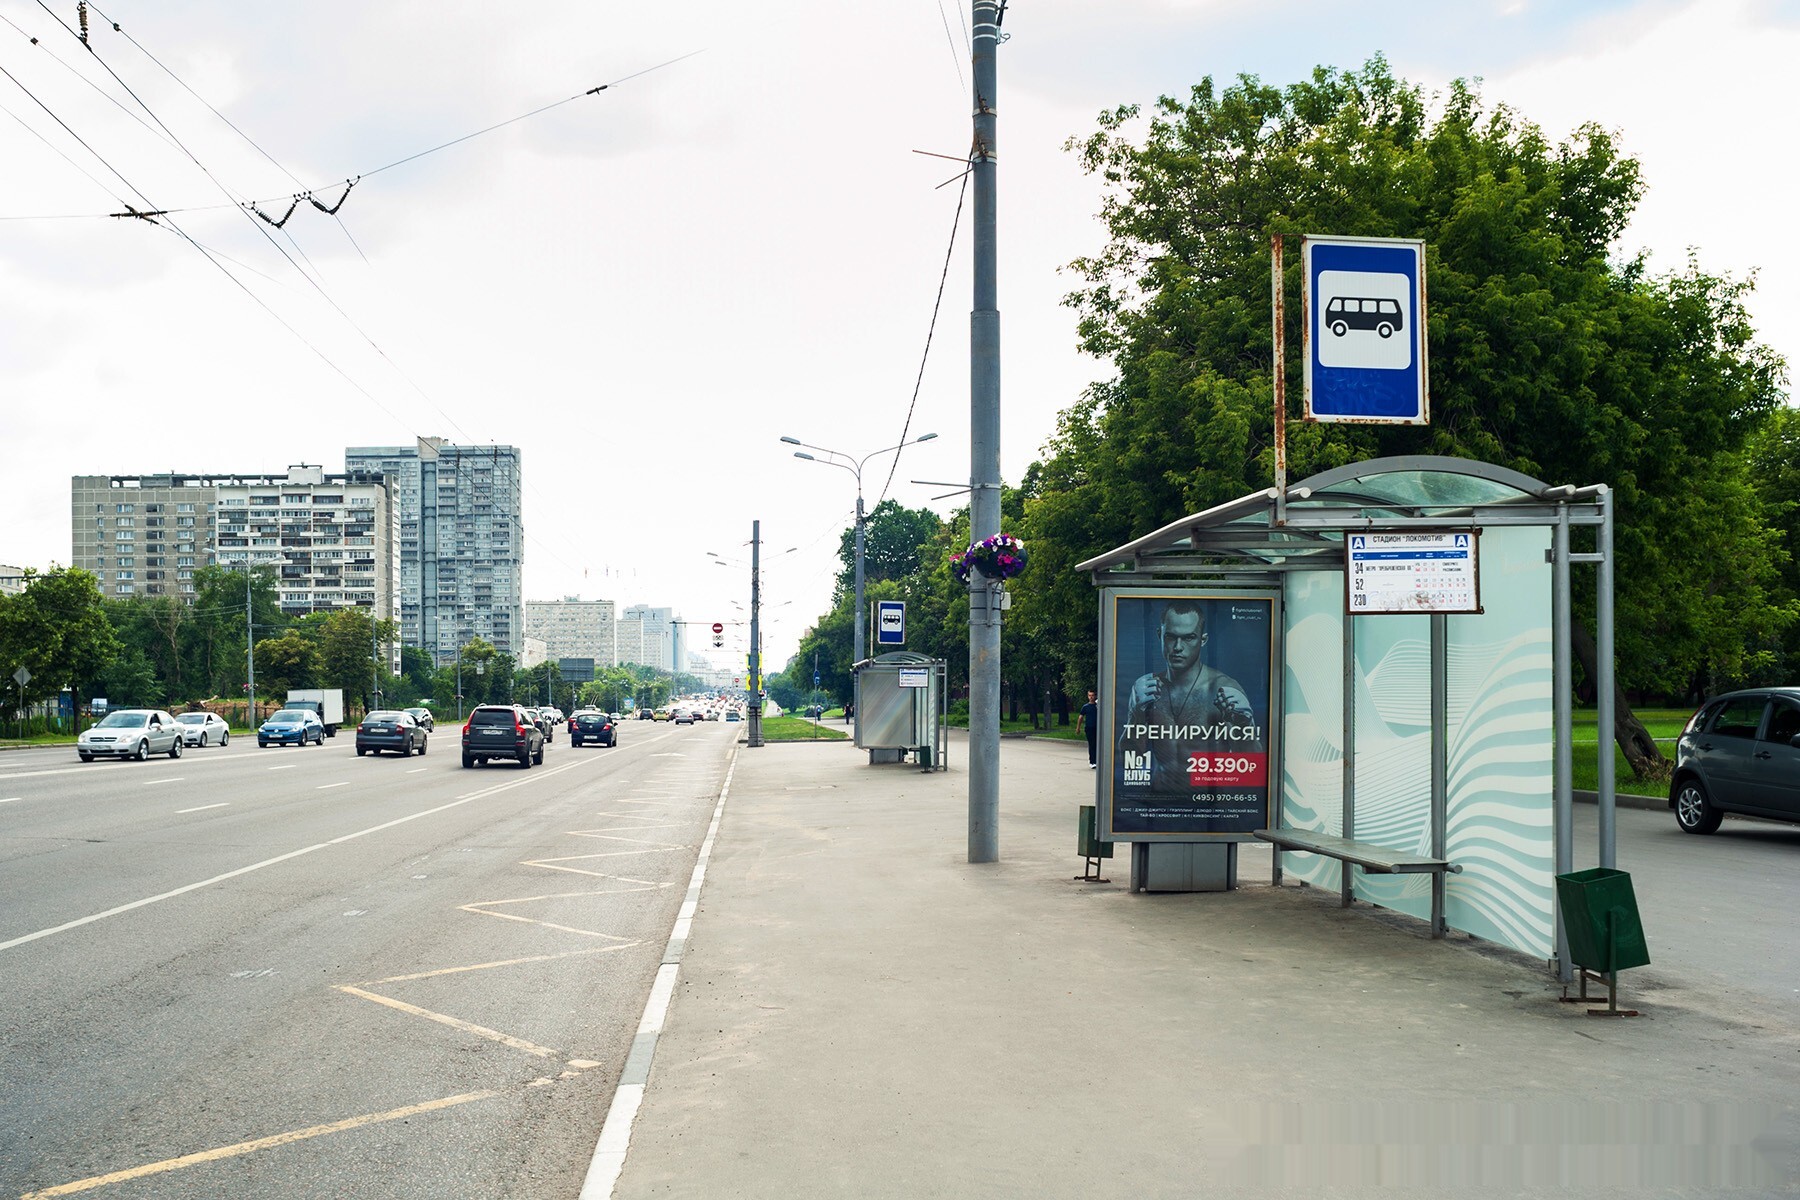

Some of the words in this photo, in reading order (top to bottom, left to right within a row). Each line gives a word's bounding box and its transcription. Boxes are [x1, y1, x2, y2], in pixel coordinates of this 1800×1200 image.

[1372, 535, 1401, 543] СТАДИОН
[1355, 562, 1364, 574] 34
[1355, 578, 1364, 590] 52
[1354, 594, 1367, 606] 230
[1123, 721, 1261, 741] ТРЕНИРУЙСЯ!
[1124, 750, 1152, 769] №1
[1124, 769, 1151, 781] КЛУБ
[1192, 794, 1215, 802] (495)
[1216, 794, 1257, 802] 970-66-55
